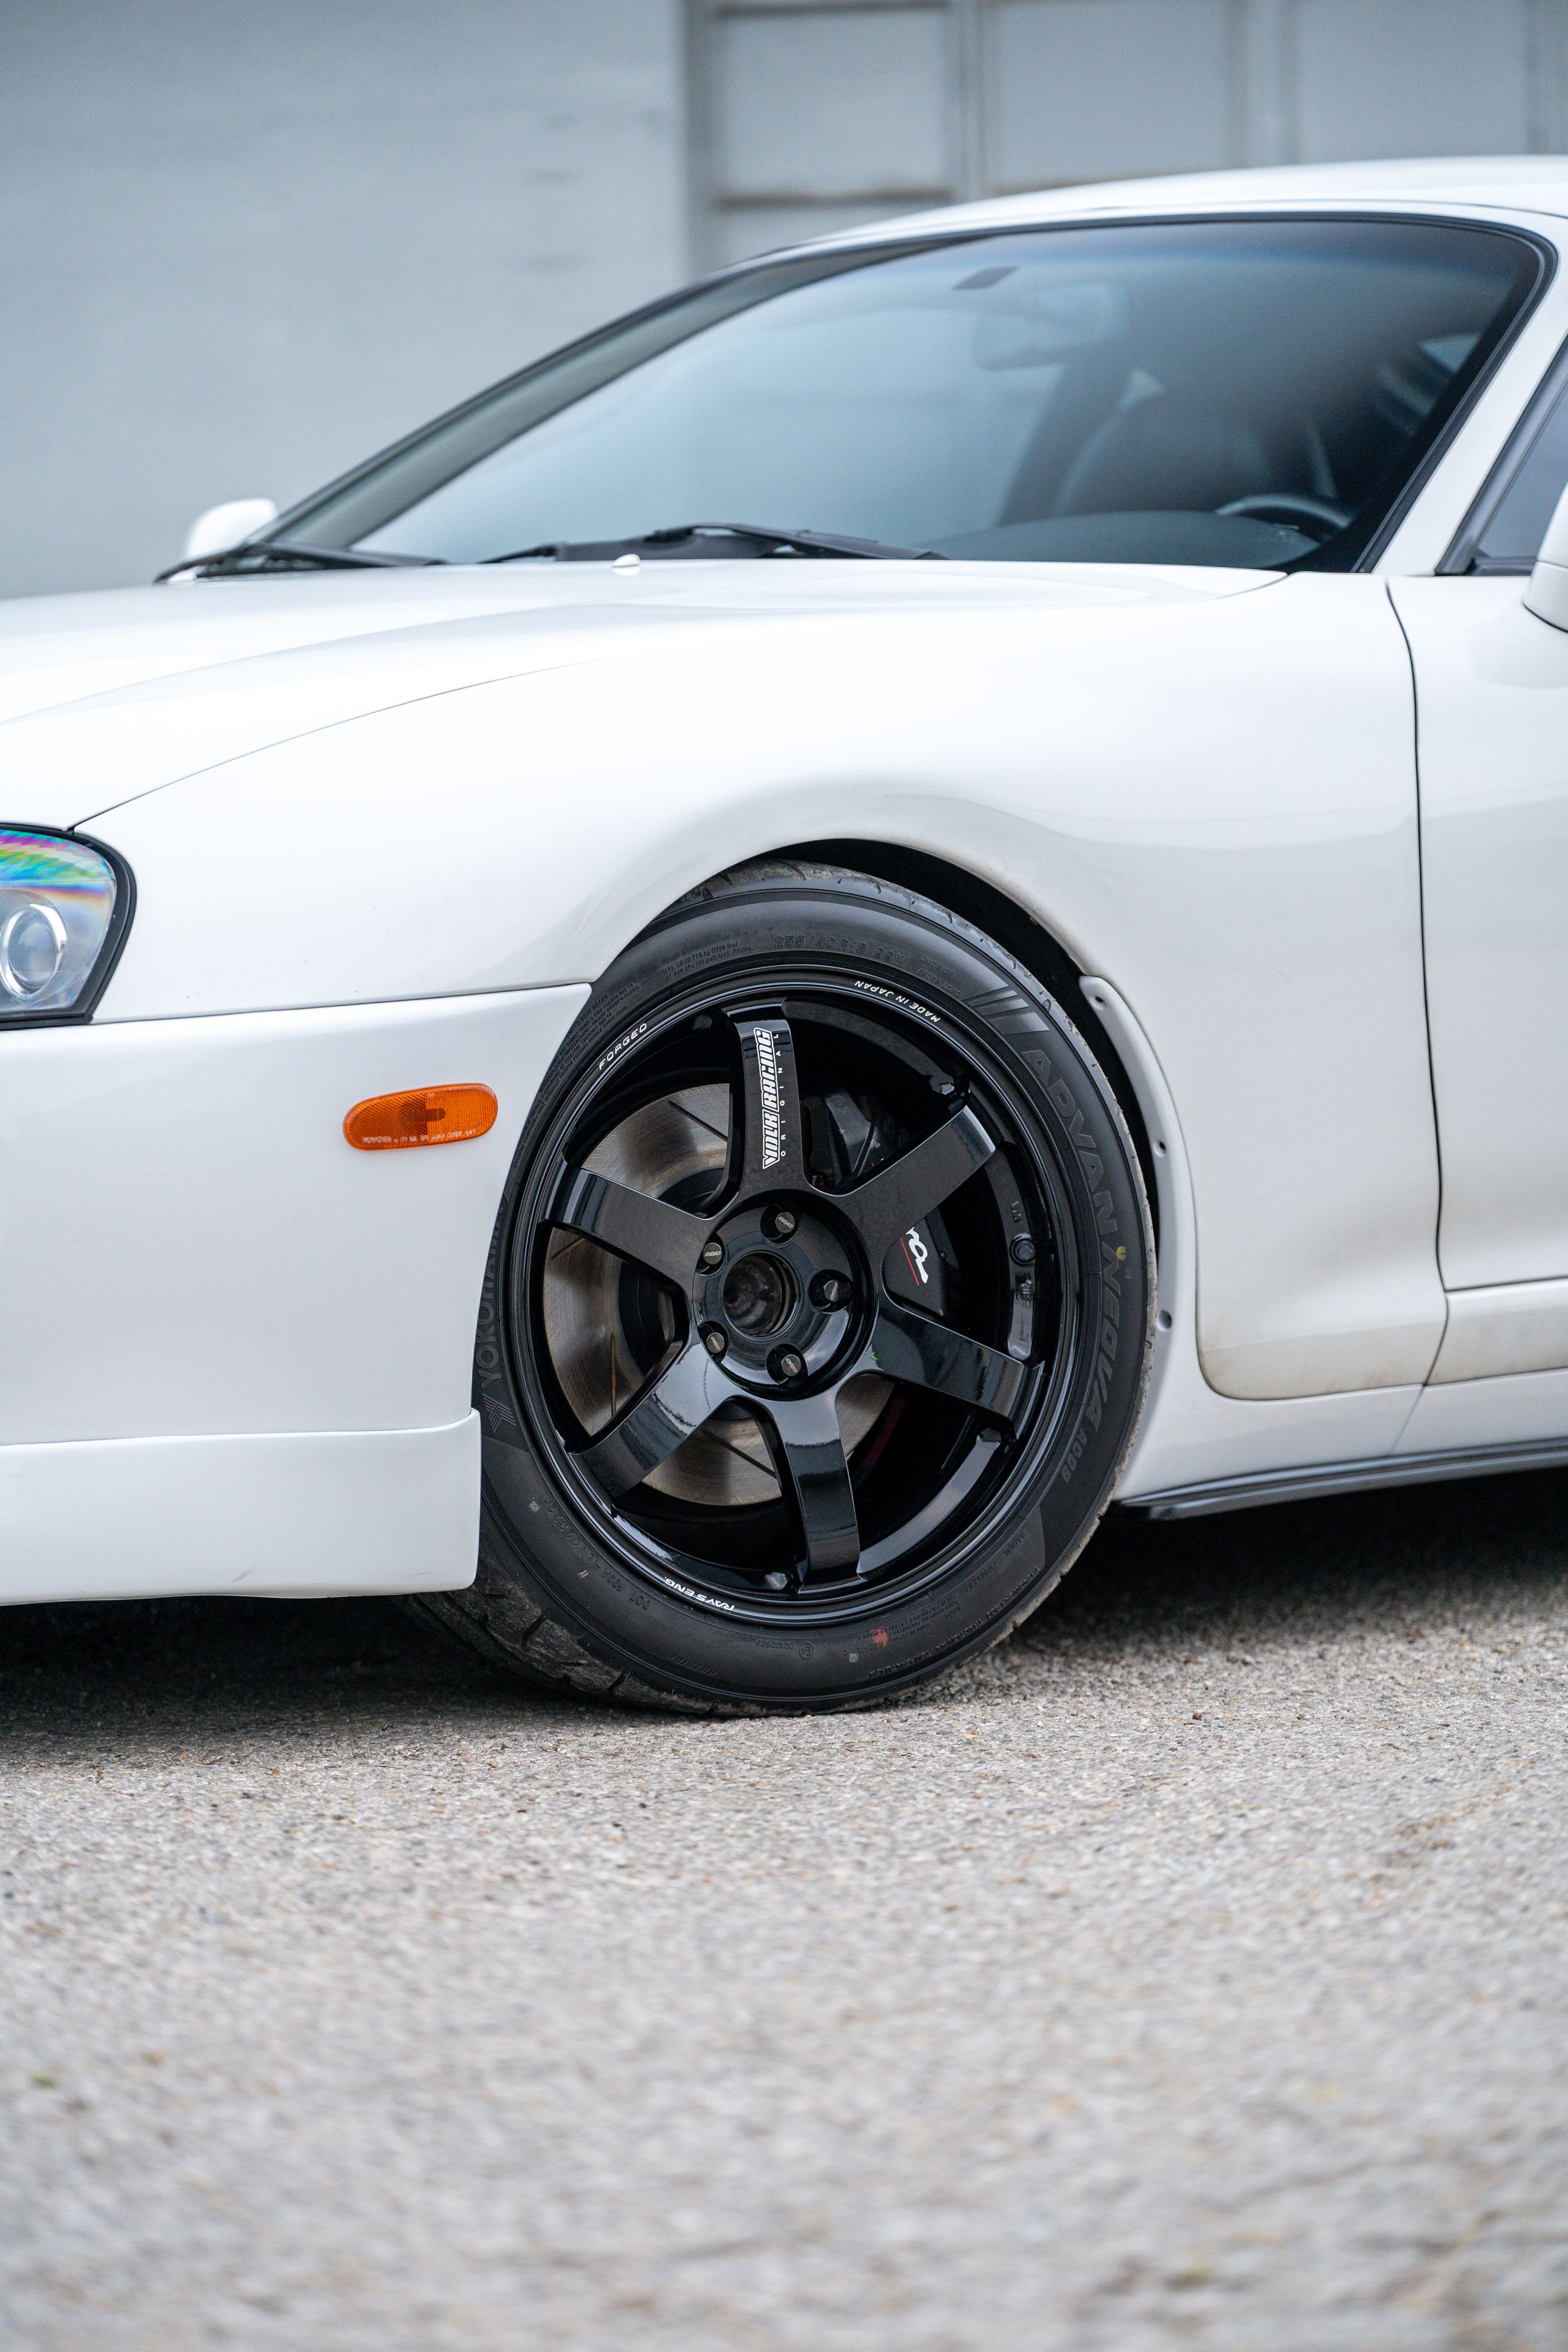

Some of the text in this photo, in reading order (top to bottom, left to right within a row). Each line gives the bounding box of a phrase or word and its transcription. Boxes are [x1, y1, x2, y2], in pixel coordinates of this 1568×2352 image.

[874, 945, 910, 970] 99W
[854, 980, 941, 1023] MADE IN JAPAN
[599, 1022, 647, 1070] FORGED
[754, 1027, 780, 1169] VOLK RACING
[774, 1034, 786, 1156] ORIGINAL
[362, 1135, 392, 1144] TOYOTA
[1021, 1049, 1118, 1235] ADVAN
[778, 1216, 794, 1228] RAYS
[1085, 1241, 1122, 1432] NEOVA
[630, 1594, 650, 1610] DOT
[664, 1576, 735, 1611] RAYS ENG.
[665, 1651, 719, 1677] OUTSIDE
